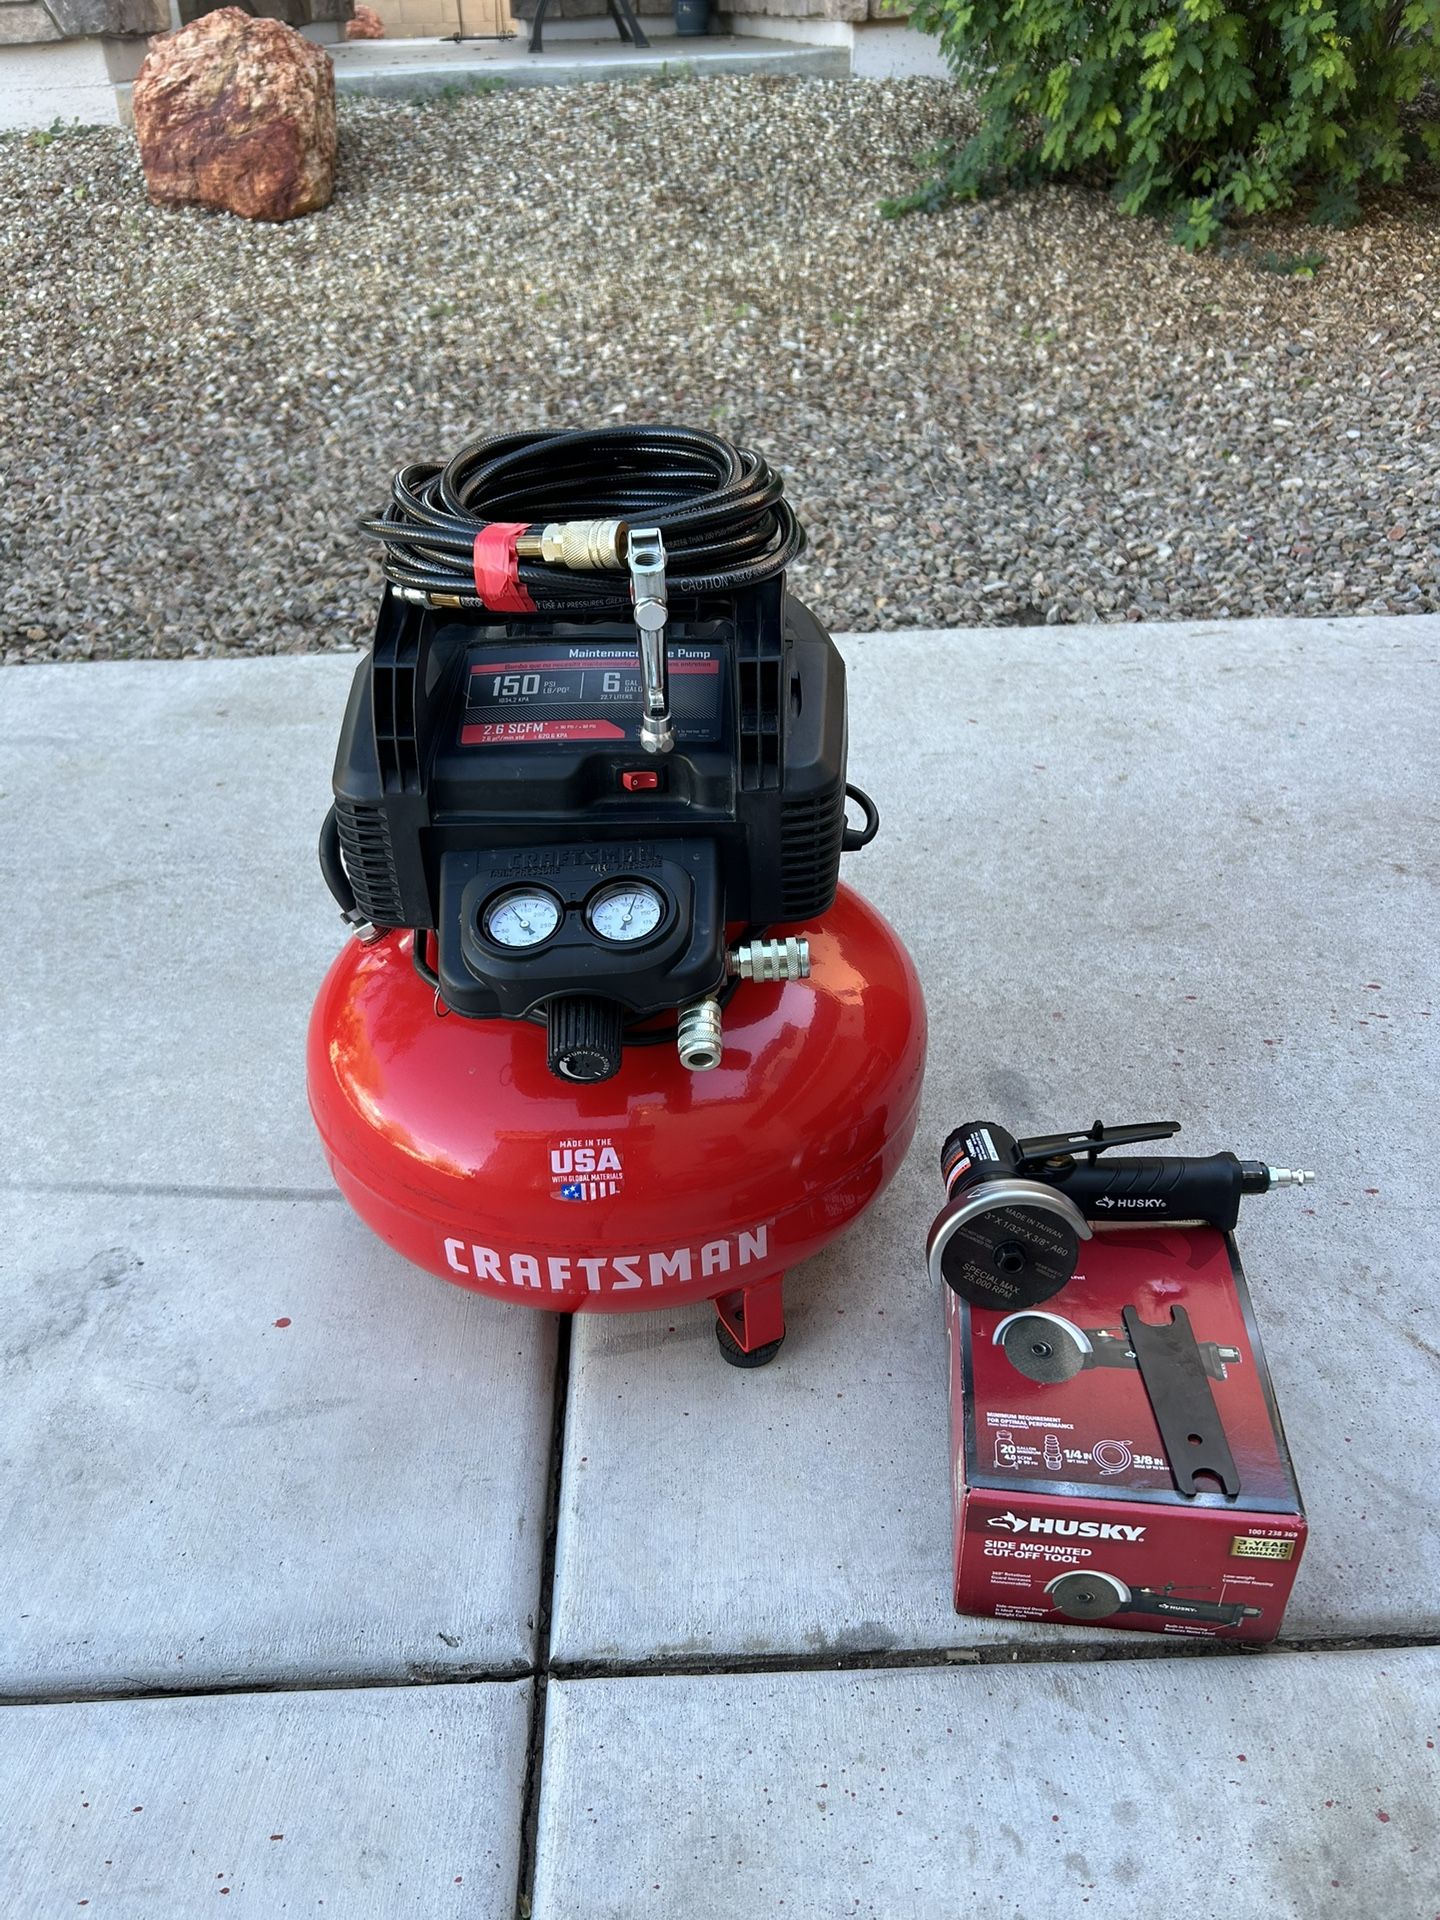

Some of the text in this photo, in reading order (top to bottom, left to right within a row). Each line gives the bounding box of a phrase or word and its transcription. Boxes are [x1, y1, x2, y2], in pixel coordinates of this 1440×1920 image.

[678, 648, 711, 660] Pump
[493, 675, 540, 696] 150
[603, 672, 620, 692] 6
[484, 724, 504, 735] 2.6
[567, 1050, 588, 1058] TURN
[560, 1138, 612, 1148] MADE IN THE
[551, 1147, 622, 1174] USA
[552, 1172, 623, 1183] WITH GLOBAL MATERIALS
[1005, 1207, 1064, 1239] MADE IN TAIWAN
[995, 1217, 1003, 1225] X
[1024, 1231, 1033, 1239] X
[1050, 1244, 1069, 1257] A60
[443, 1225, 767, 1291] CRAFTSMAN
[962, 1263, 1019, 1294] SPECIAL MAX
[992, 1285, 1012, 1299] RPM
[987, 1411, 1062, 1422] MINIMUM REQUIREMENT
[1000, 1418, 1028, 1426] OPTIMAL
[1029, 1420, 1074, 1430] PERFORMANCE
[1000, 1444, 1016, 1454] 20
[1063, 1449, 1083, 1460] 1/4
[1132, 1454, 1164, 1466] 3/8 IN
[1029, 1517, 1147, 1541] HUSKY
[1268, 1529, 1282, 1537] 238
[984, 1539, 1093, 1557] SIDE MOUNTED
[1237, 1546, 1288, 1554] LIMITED
[1238, 1539, 1289, 1549] 3-YEAR
[983, 1548, 1081, 1564] CUT-OFF TOOL
[1236, 1550, 1288, 1558] WARRANTY
